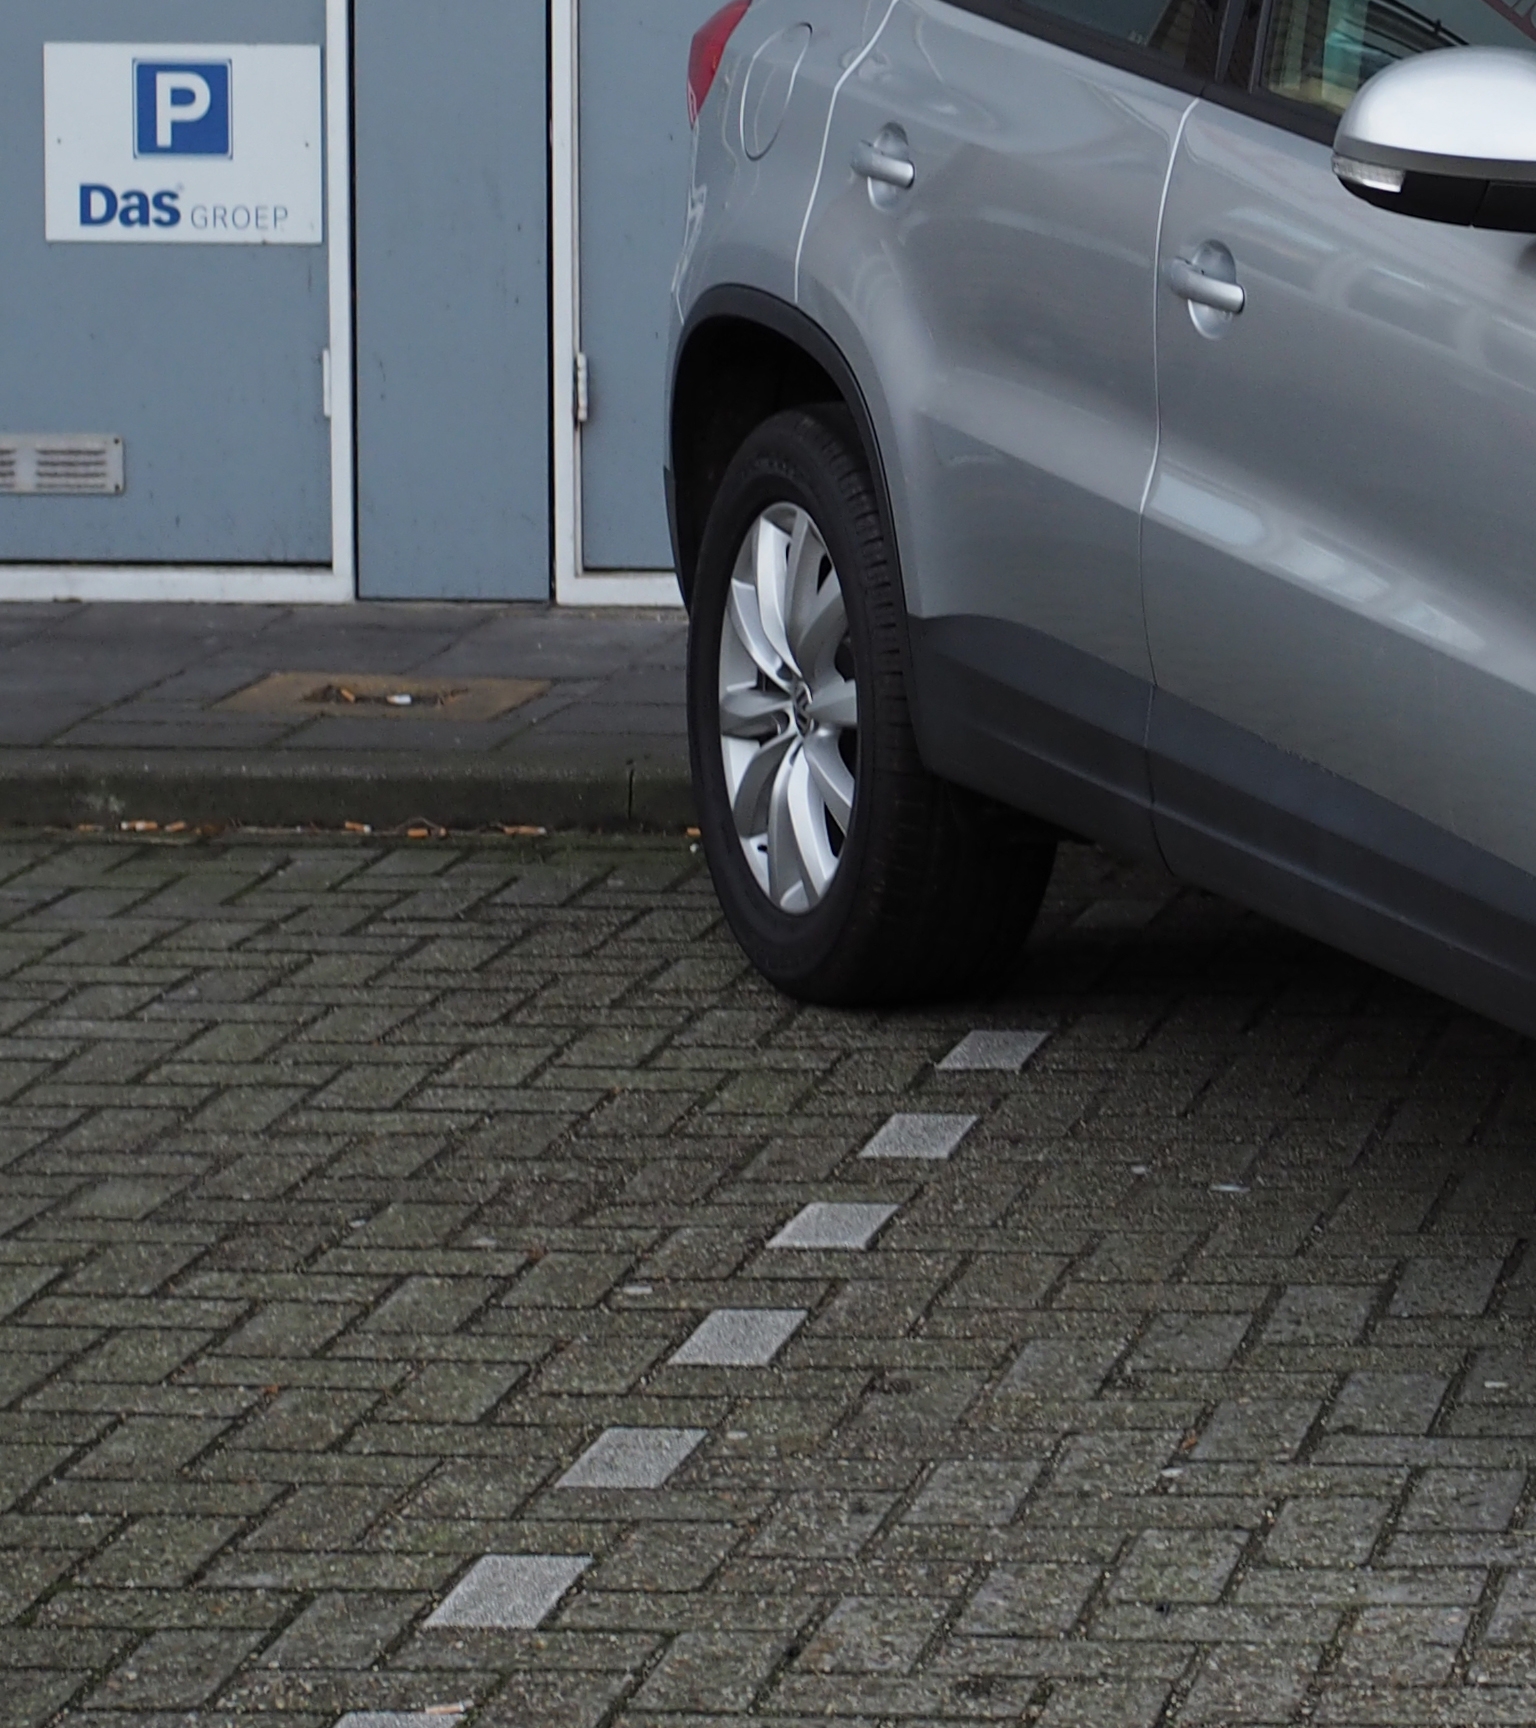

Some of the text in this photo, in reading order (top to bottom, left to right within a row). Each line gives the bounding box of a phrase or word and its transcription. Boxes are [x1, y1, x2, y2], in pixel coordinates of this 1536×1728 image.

[155, 71, 211, 149] P
[79, 183, 288, 230] Das GROEP
